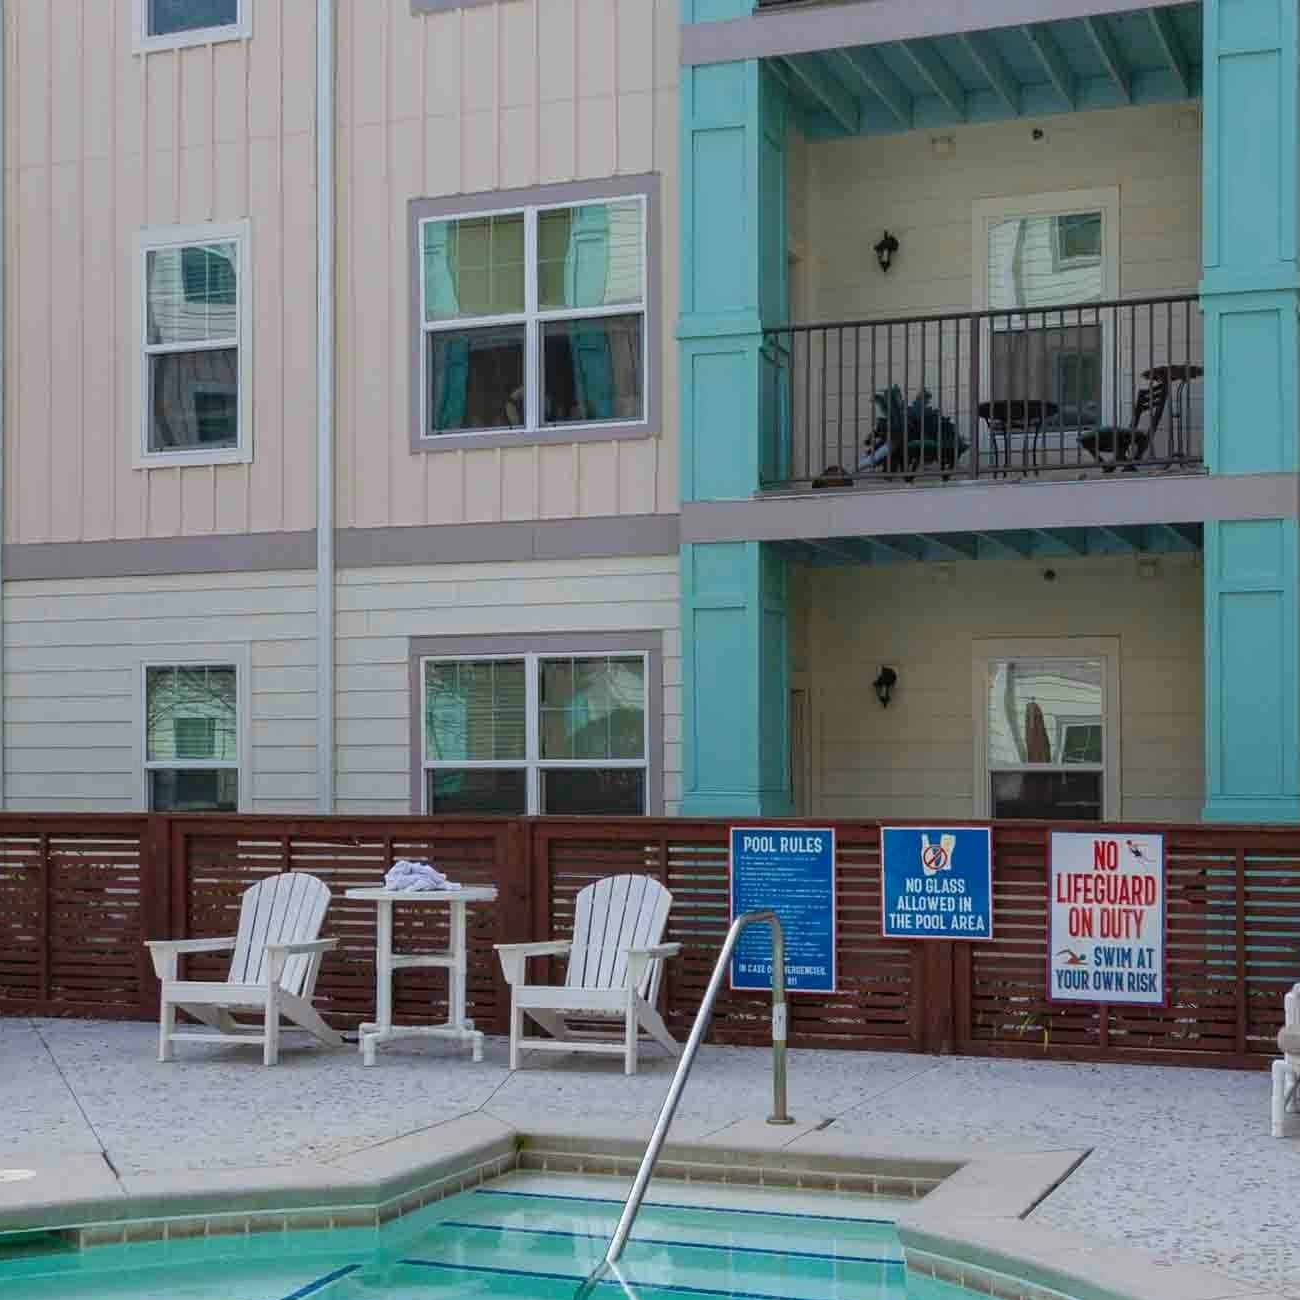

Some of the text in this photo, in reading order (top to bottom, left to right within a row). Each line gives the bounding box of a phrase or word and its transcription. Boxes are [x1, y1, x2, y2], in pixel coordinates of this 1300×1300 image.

[743, 836, 822, 853] POOL RULES
[1093, 840, 1119, 870] NO
[906, 878, 965, 893] NO GLASS
[1056, 873, 1156, 906] LIFEGUARD
[897, 895, 972, 912] ALLOWED IN
[889, 913, 986, 931] THE POOL AREA
[1068, 907, 1144, 939] ON DUTY
[1093, 947, 1155, 969] SWIM AT
[1056, 969, 1158, 993] YOUR OWN RISK
